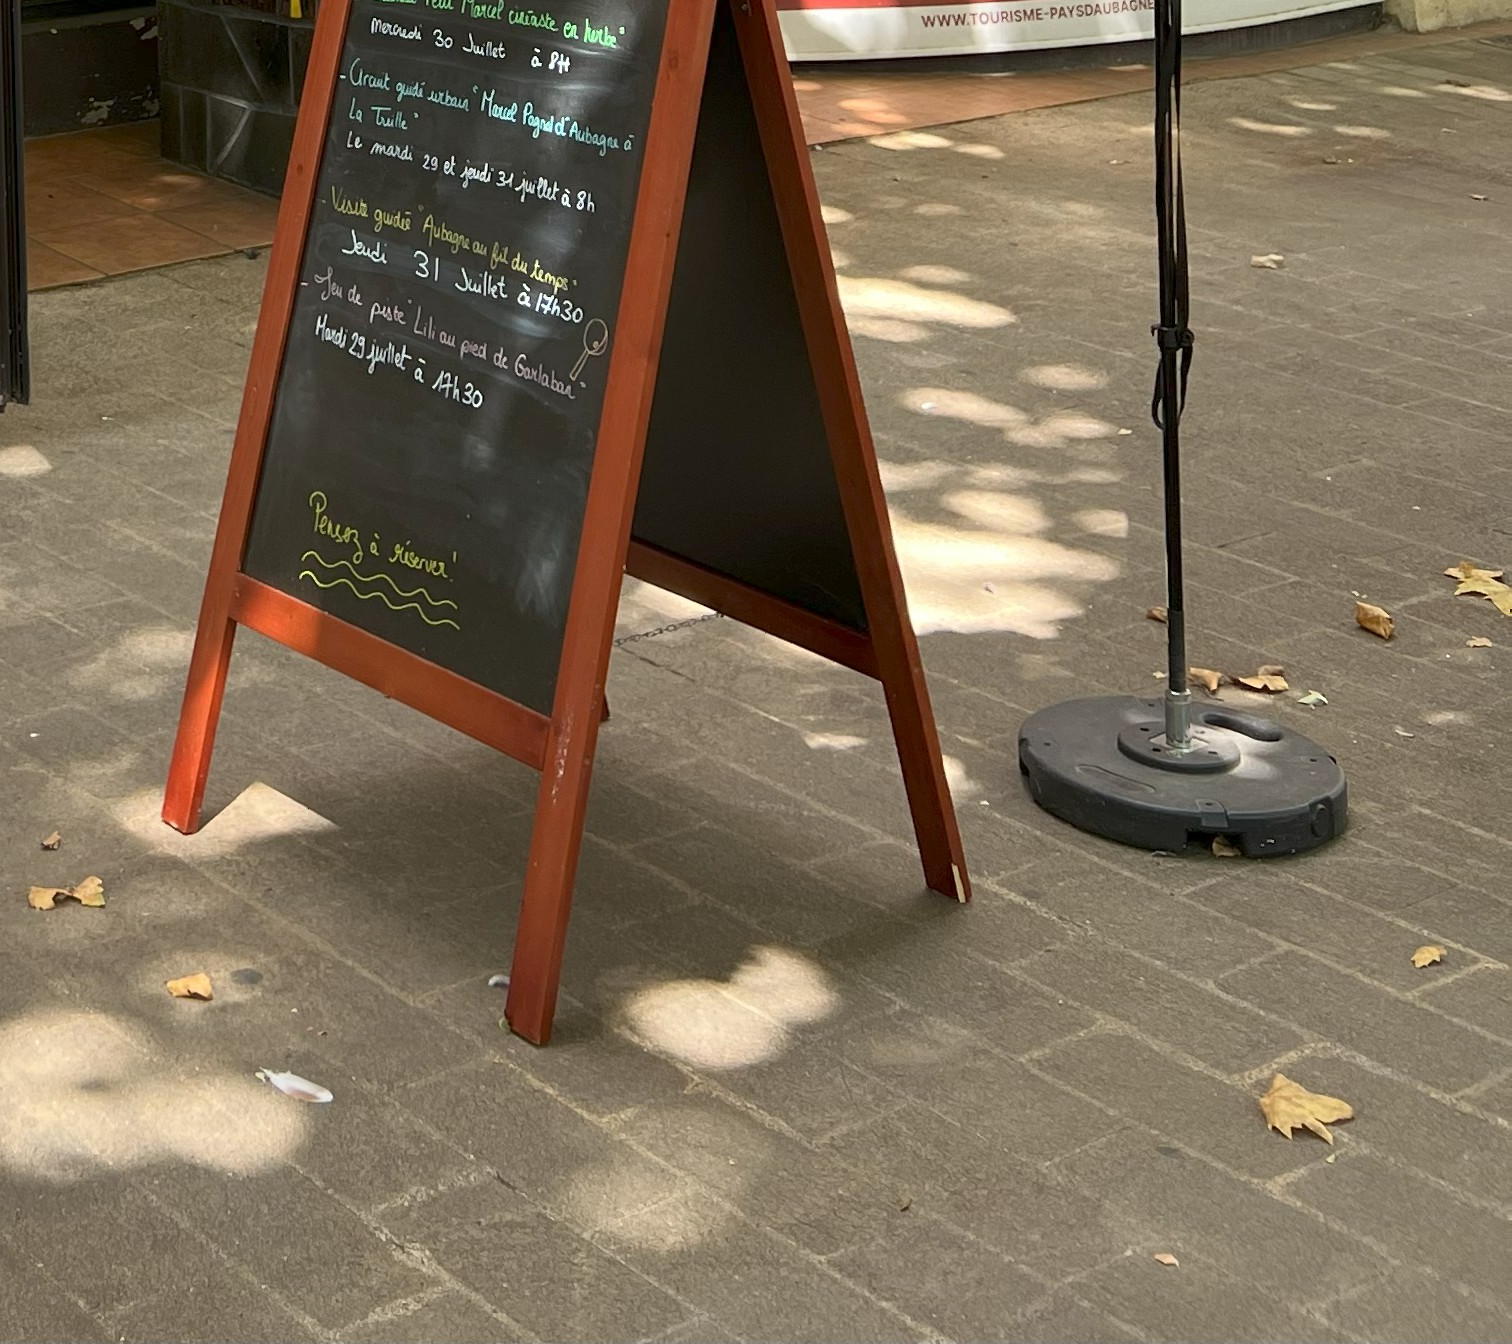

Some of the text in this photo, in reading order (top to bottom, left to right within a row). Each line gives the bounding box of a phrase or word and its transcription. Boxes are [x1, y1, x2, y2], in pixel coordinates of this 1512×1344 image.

[370, 17, 422, 41] Mercredi
[433, 28, 453, 48] 30
[462, 33, 506, 58] Juillet
[531, 47, 542, 68] à
[563, 21, 579, 40] en
[348, 97, 363, 123] La
[395, 81, 426, 103] guidé
[427, 89, 470, 112] urbain
[624, 134, 635, 151] à
[347, 130, 596, 213] Le mardi 29 et jeudi 31 juillet à 8h
[331, 185, 369, 218] Visite
[373, 208, 413, 232] guidée
[472, 239, 488, 257] au
[491, 242, 509, 269] fil
[511, 252, 528, 272] du
[342, 229, 584, 324] Jeudi 31 Juillet à 17h30
[314, 267, 509, 370] Jeu de piste au pied de
[314, 313, 484, 409] Mardi 29 juillet à 17h30
[309, 491, 363, 565] Pensez
[369, 533, 381, 556] à
